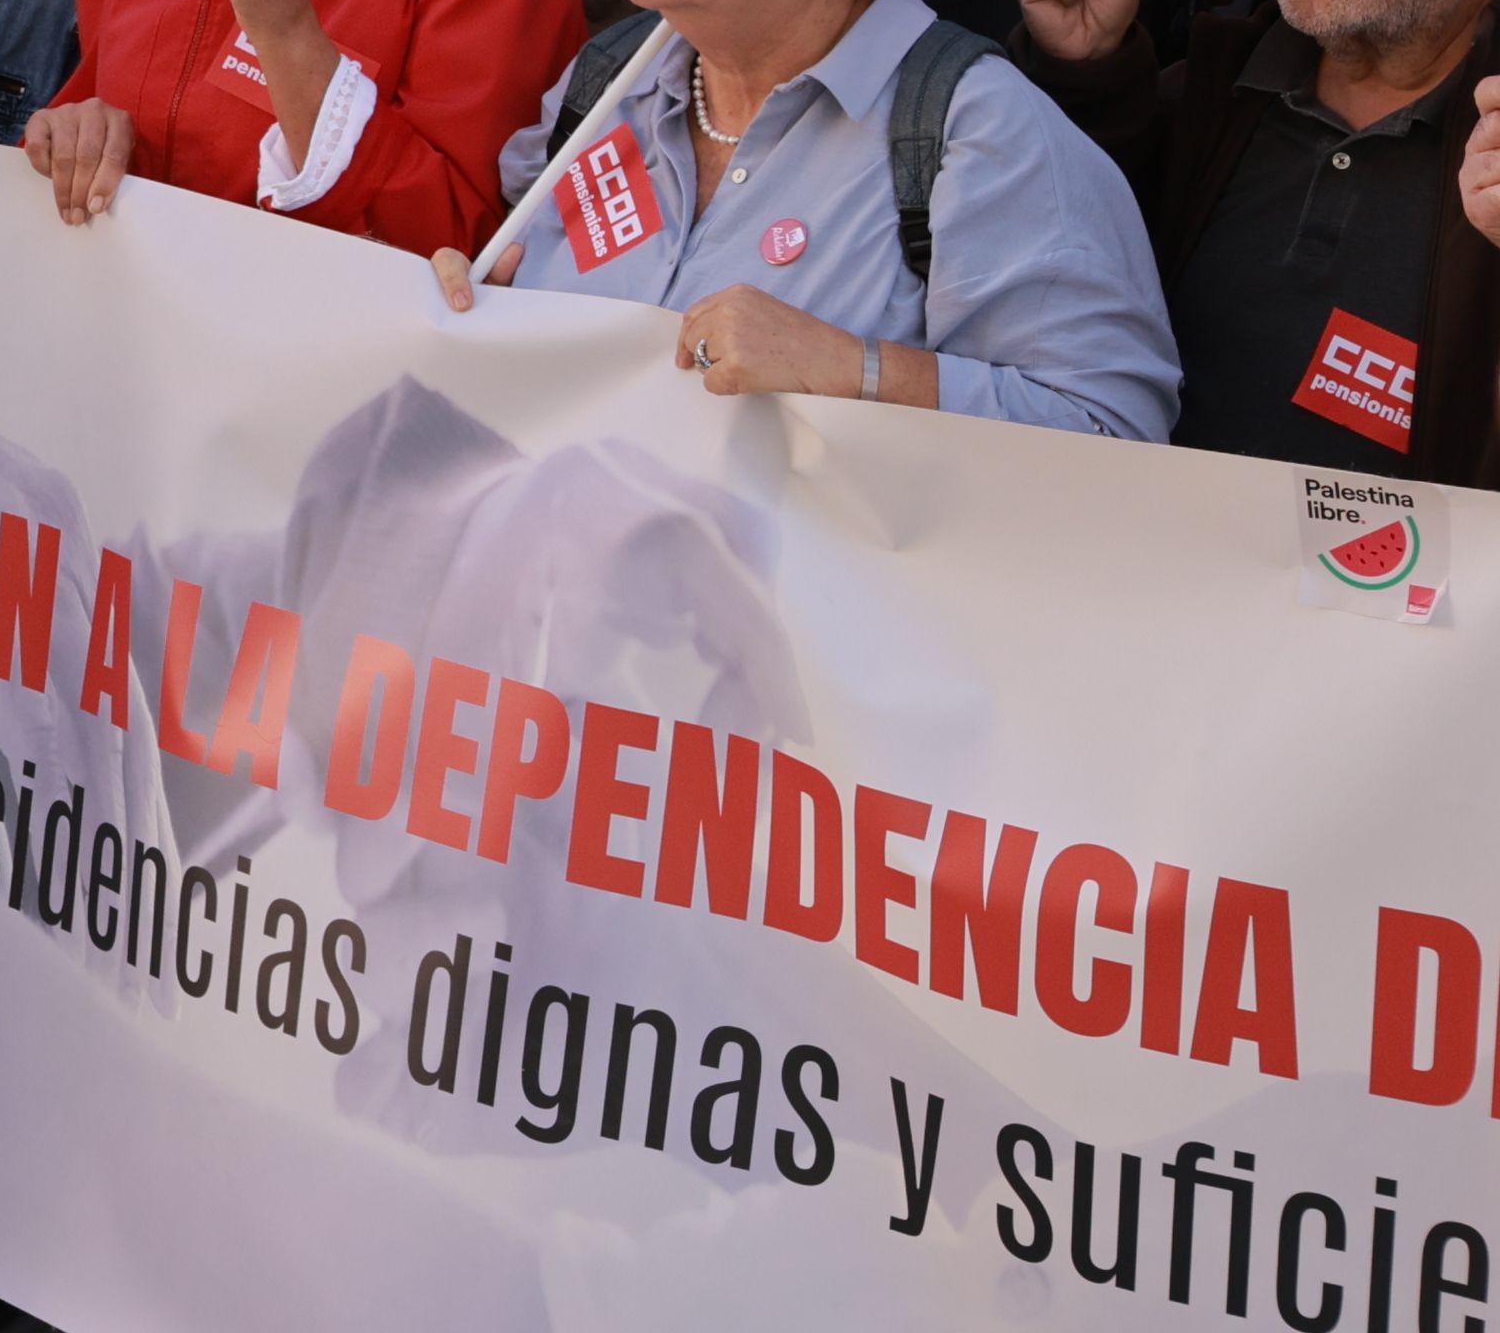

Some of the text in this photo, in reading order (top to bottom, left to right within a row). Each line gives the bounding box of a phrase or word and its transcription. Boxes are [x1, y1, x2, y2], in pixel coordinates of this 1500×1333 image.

[568, 161, 608, 258] pensionistas
[588, 140, 644, 248] CCOO
[1305, 478, 1414, 508] Palestina
[80, 548, 131, 731] A
[158, 578, 301, 791] LA
[324, 633, 1298, 1080] DEPENDENCIA
[1369, 906, 1500, 1120] D
[407, 933, 841, 1186] dignas
[888, 1075, 945, 1236] y
